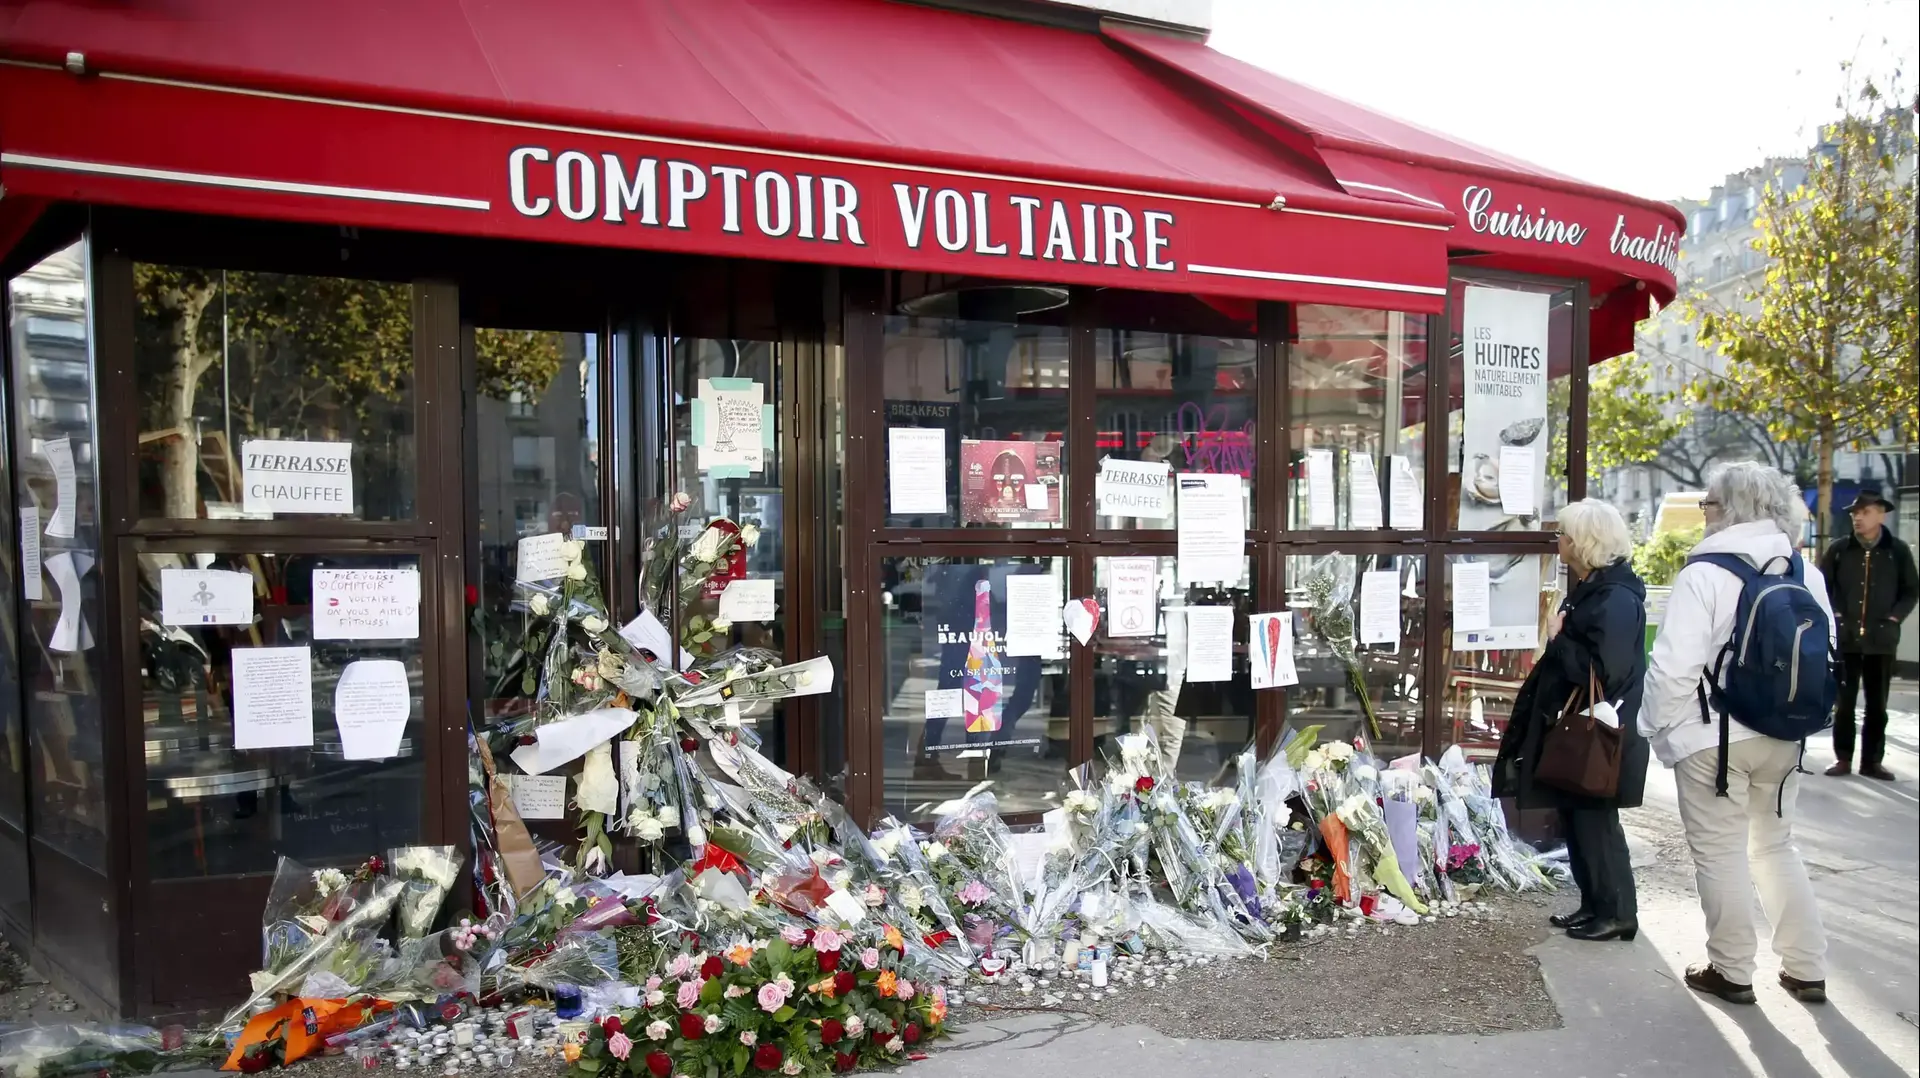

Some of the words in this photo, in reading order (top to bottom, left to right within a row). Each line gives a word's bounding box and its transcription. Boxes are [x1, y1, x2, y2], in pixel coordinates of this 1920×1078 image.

[508, 146, 868, 246] COMPTOIR
[892, 183, 1175, 272] VOLTAIRE
[1462, 185, 1587, 246] Cuisine
[1473, 326, 1492, 340] LES
[1474, 342, 1540, 370] HUITRES
[1474, 368, 1541, 386] NATURELLEMENT
[1474, 383, 1523, 398] INIMITABLES
[891, 404, 951, 418] BREAKFAST
[247, 453, 349, 475] TERRASSE
[1104, 469, 1167, 488] TERRASSE
[251, 484, 343, 502] CHAUFFEE
[1105, 493, 1161, 509] CHAUFFEE
[589, 529, 607, 537] Tirez
[330, 581, 384, 591] COMPTOIR
[348, 596, 399, 604] VOLTAIRE
[327, 608, 342, 616] ON
[346, 608, 369, 616] VOUS
[949, 669, 964, 678] ÇA
[967, 668, 980, 676] SE
